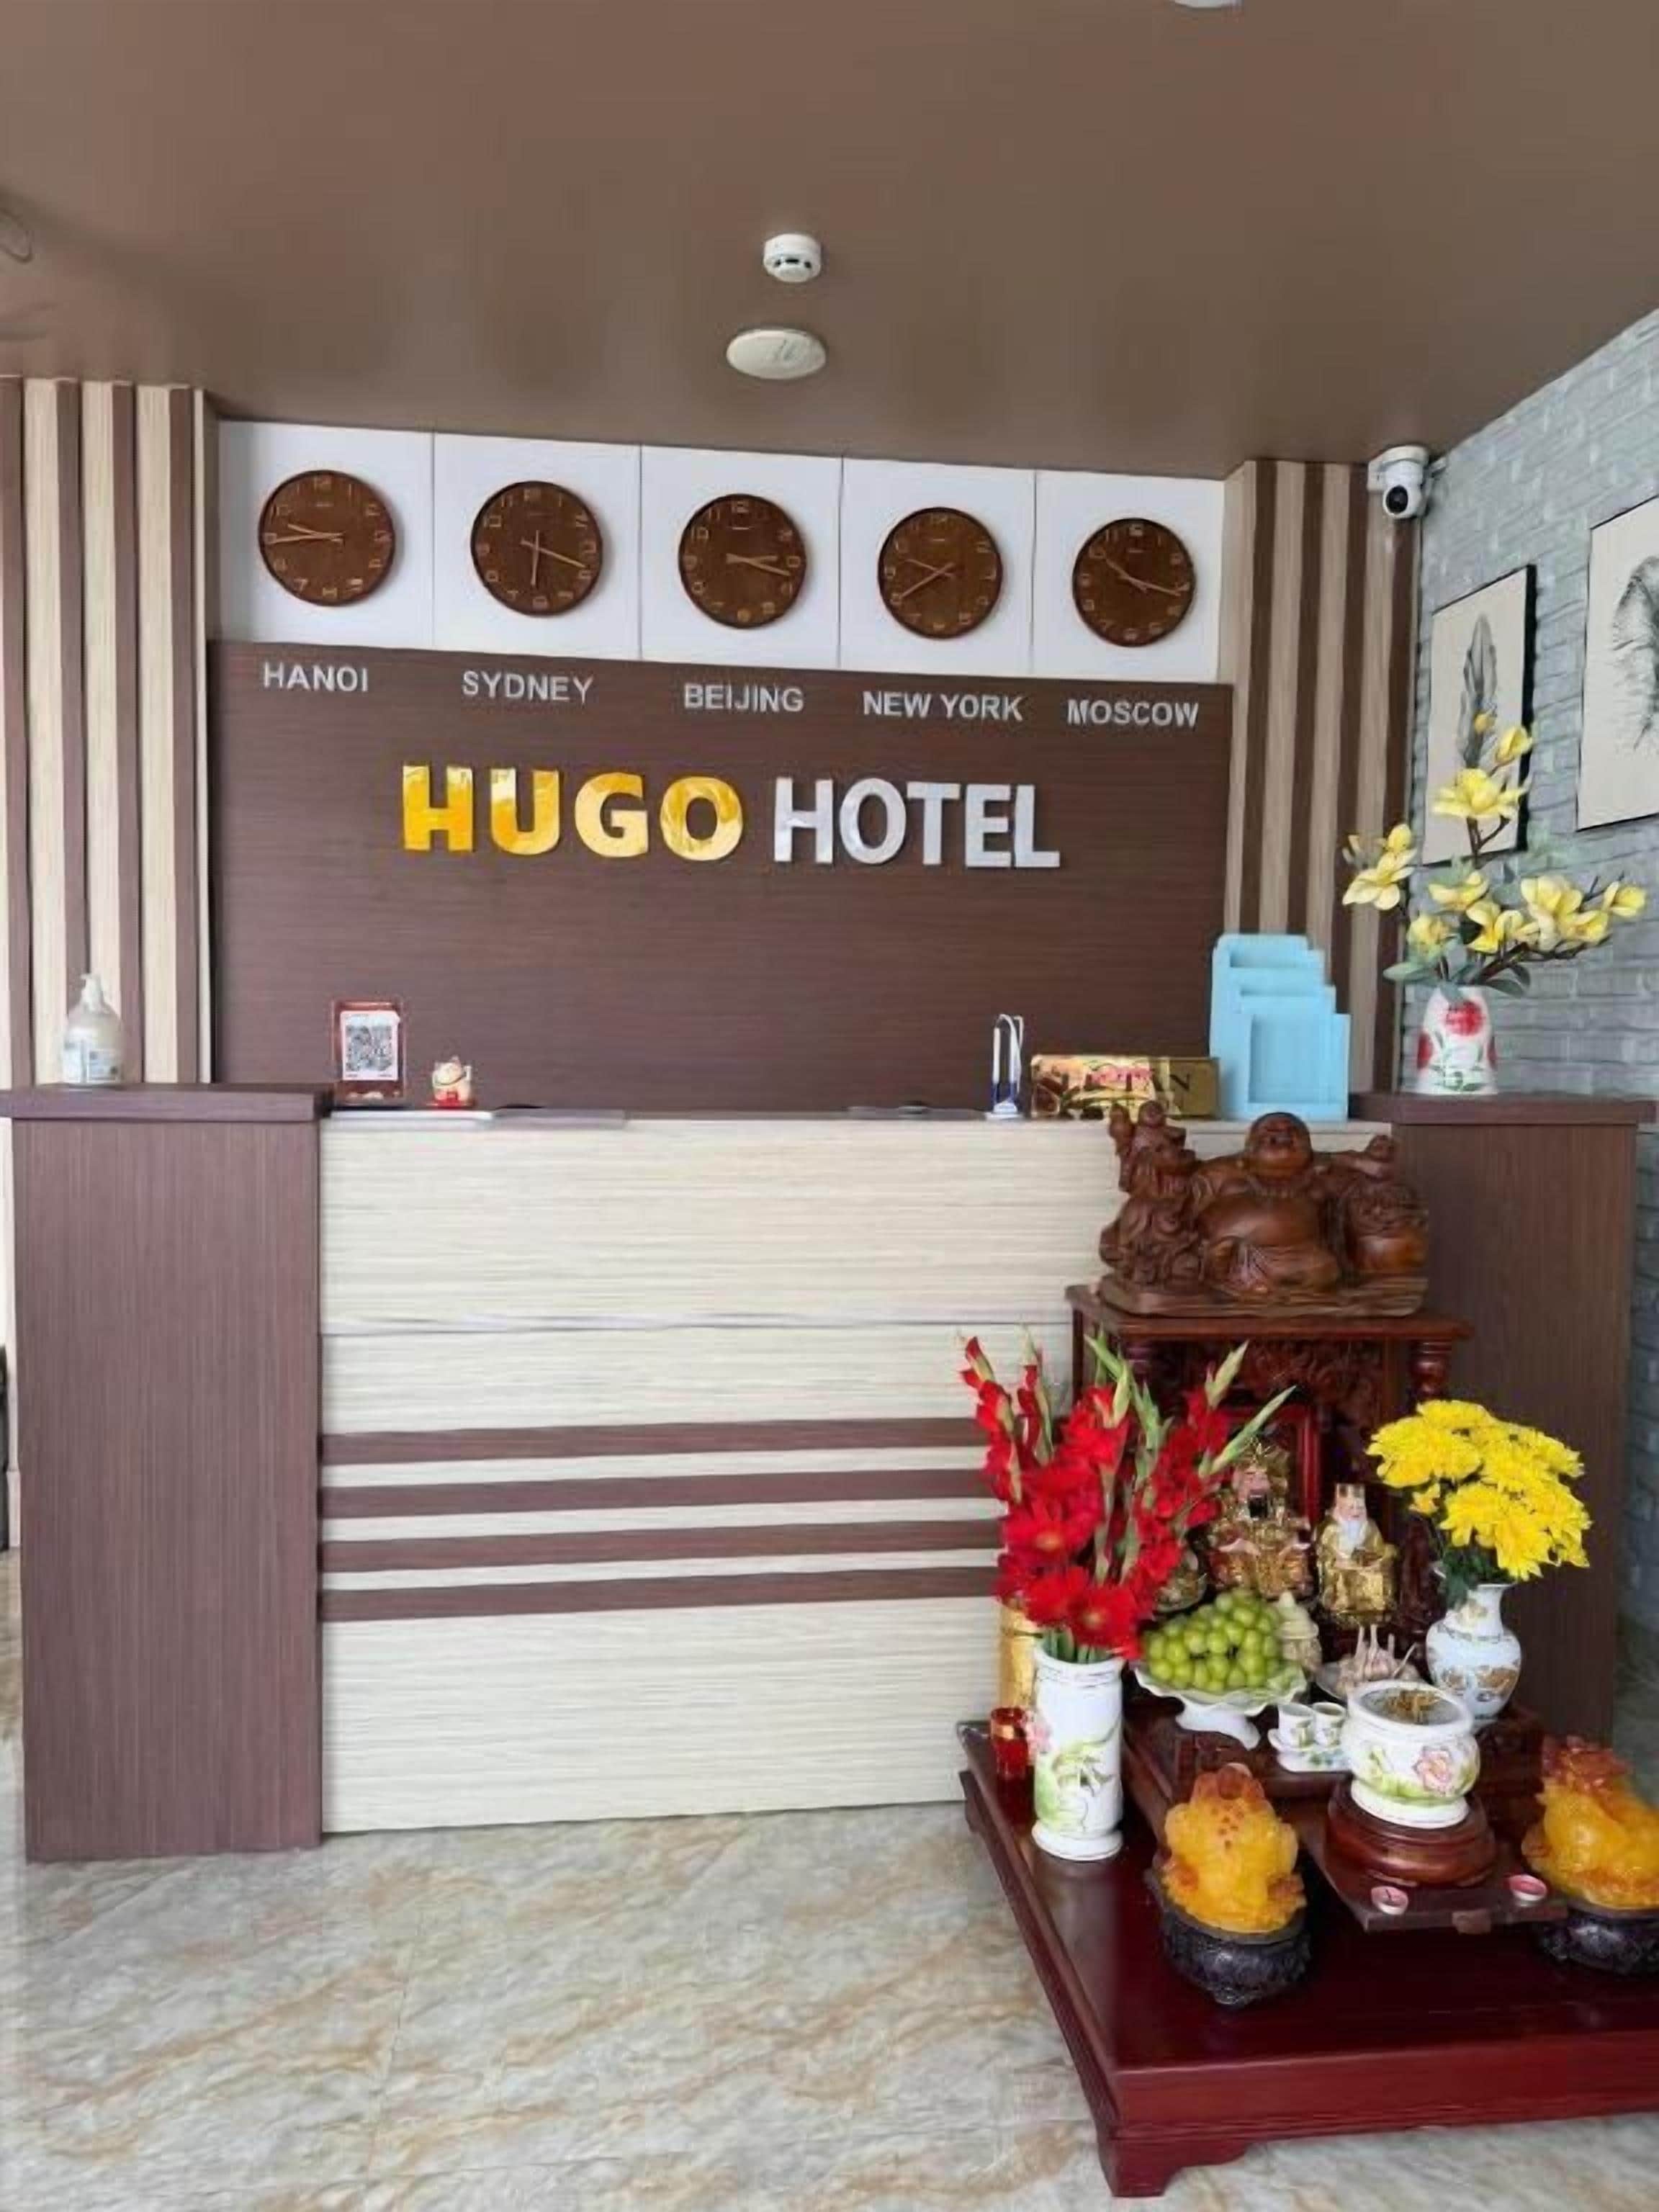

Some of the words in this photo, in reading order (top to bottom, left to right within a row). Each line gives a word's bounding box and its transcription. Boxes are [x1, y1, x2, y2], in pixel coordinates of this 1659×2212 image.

[263, 662, 369, 693] HANOI
[462, 670, 594, 703] SYDNEY
[684, 683, 805, 714] BEIJING
[863, 691, 931, 718] NEW
[940, 694, 1023, 721] YORK
[1066, 699, 1200, 728] MOSCOW
[402, 765, 744, 860] HUGO
[773, 777, 1060, 870] HOTEL
